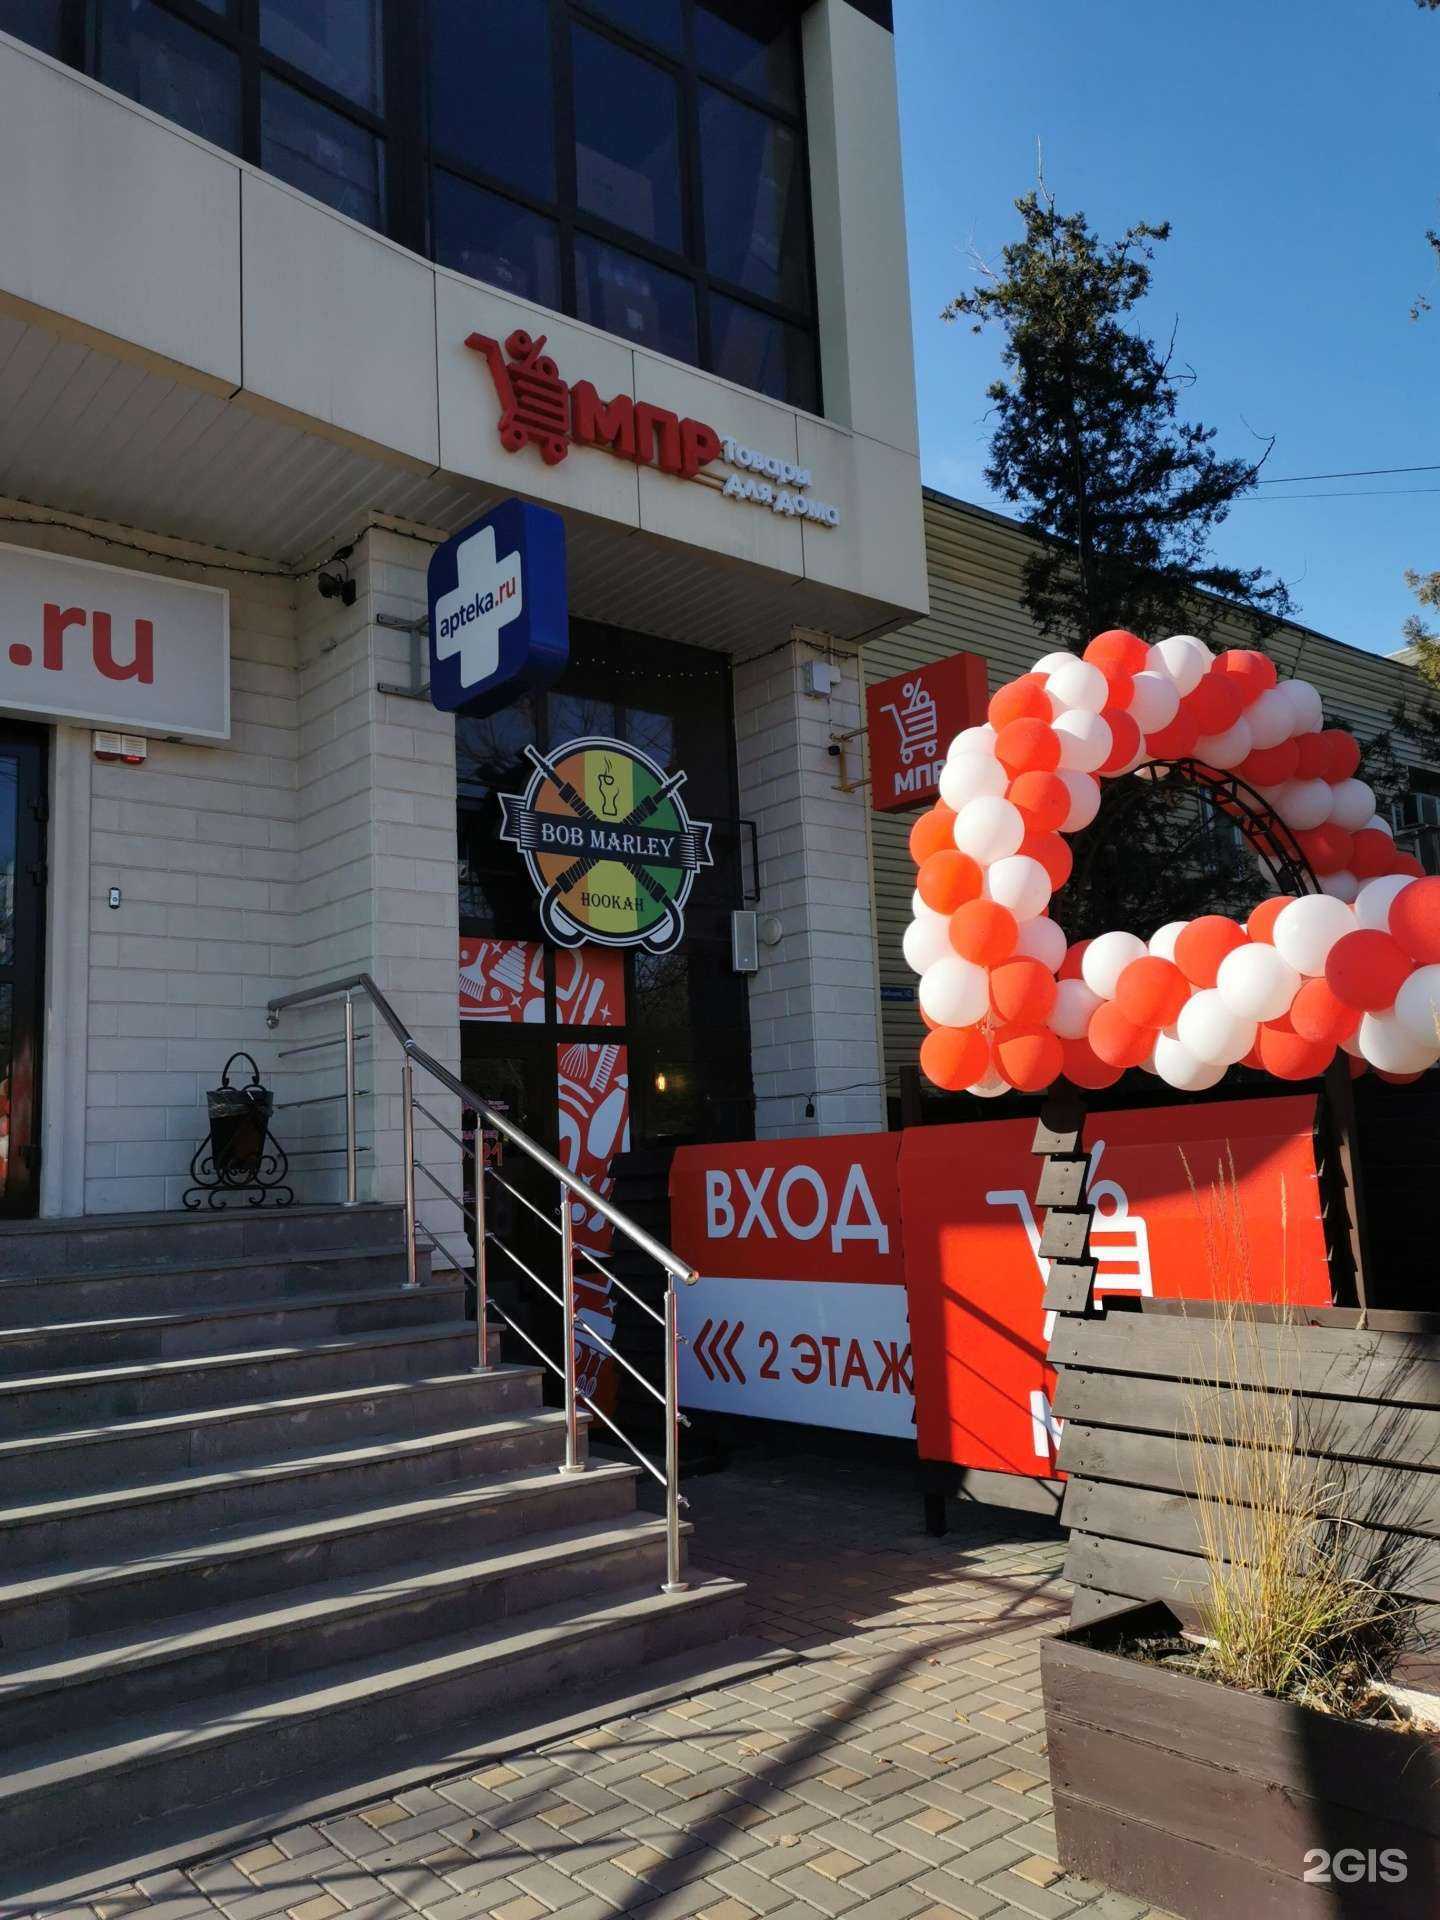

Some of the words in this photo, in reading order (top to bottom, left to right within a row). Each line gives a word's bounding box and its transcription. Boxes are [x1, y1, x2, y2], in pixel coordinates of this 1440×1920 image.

[571, 380, 722, 478] МПР
[722, 435, 812, 488] Товары
[440, 576, 516, 638] apteka.ru
[8, 603, 154, 684] .ru
[541, 822, 584, 847] BOB
[590, 829, 675, 858] MARLEY
[581, 891, 645, 912] HOOKAH
[705, 1163, 890, 1254] ВХОД
[758, 1330, 781, 1380] 2
[790, 1333, 916, 1396] ЭТАЖ
